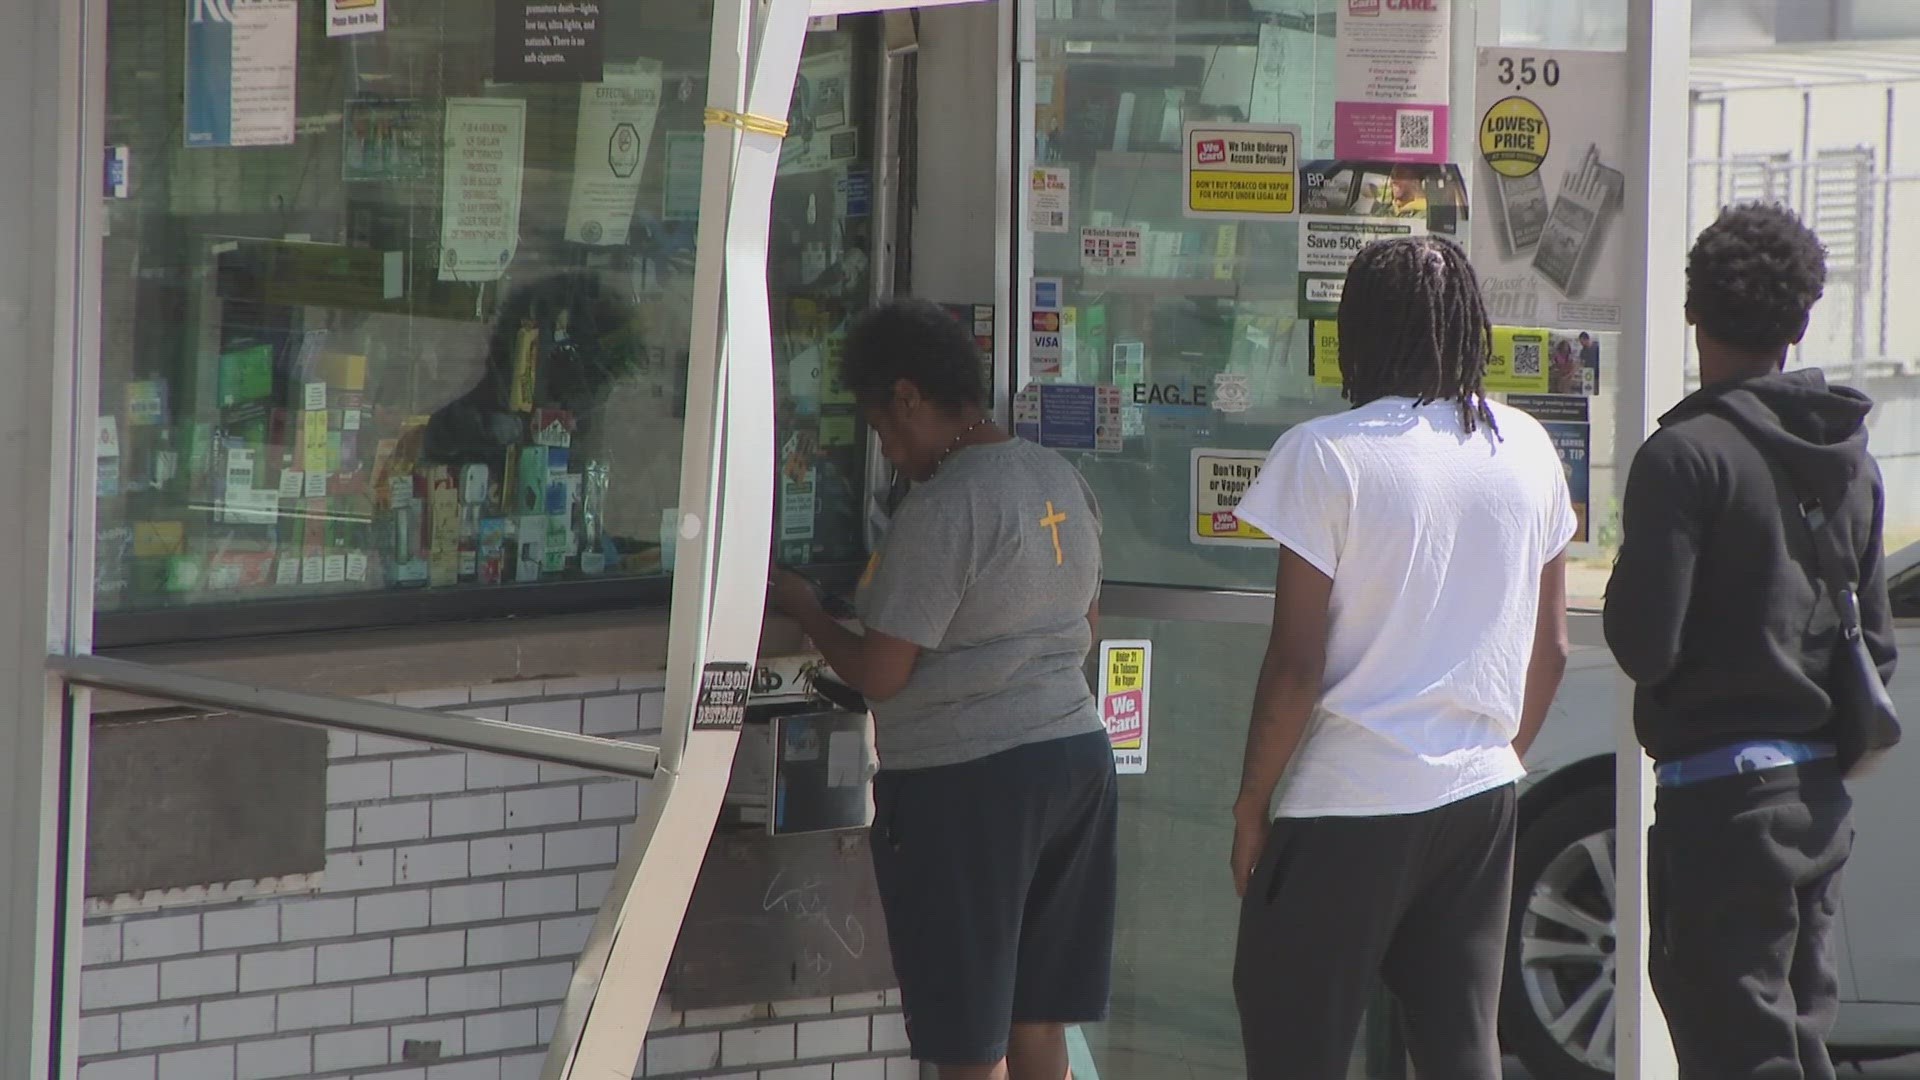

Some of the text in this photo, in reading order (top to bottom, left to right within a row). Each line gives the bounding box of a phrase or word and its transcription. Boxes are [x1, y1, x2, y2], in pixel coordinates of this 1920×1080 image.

[526, 5, 557, 16] premature
[525, 19, 536, 30] low
[548, 19, 563, 30] ultra
[564, 19, 582, 32] lights,
[584, 19, 595, 30] and
[525, 35, 585, 46] naturals. There is no
[524, 52, 566, 65] safe cigarette.
[1498, 57, 1560, 90] 3.50
[1487, 117, 1544, 137] LOWEST
[1228, 142, 1288, 154] We Take Underage
[1494, 134, 1535, 151] PRICE
[1202, 144, 1221, 154] We
[1199, 151, 1224, 162] Card
[1231, 154, 1287, 166] Access Seriously
[1196, 180, 1289, 191] DON'T BUY TOBACCO OR VAPOR
[1199, 190, 1287, 201] FOR PEOPLE UNDER LEGAL AGE
[1307, 236, 1337, 249] Save
[1320, 281, 1335, 290] Plus
[1311, 289, 1327, 298] back
[1035, 336, 1059, 348] VISA
[1569, 449, 1585, 460] TIP
[1213, 463, 1234, 476] Don't
[1236, 465, 1252, 480] Buy
[1210, 480, 1219, 491] or
[1221, 480, 1245, 494] Vapor
[1115, 651, 1137, 663] Under 21
[1112, 663, 1139, 674] No Tobacco
[703, 671, 750, 690] WILSON
[1115, 676, 1136, 687] No Vapor
[1111, 695, 1135, 716] We
[1106, 711, 1140, 735] Card
[1131, 755, 1142, 766] Ready
